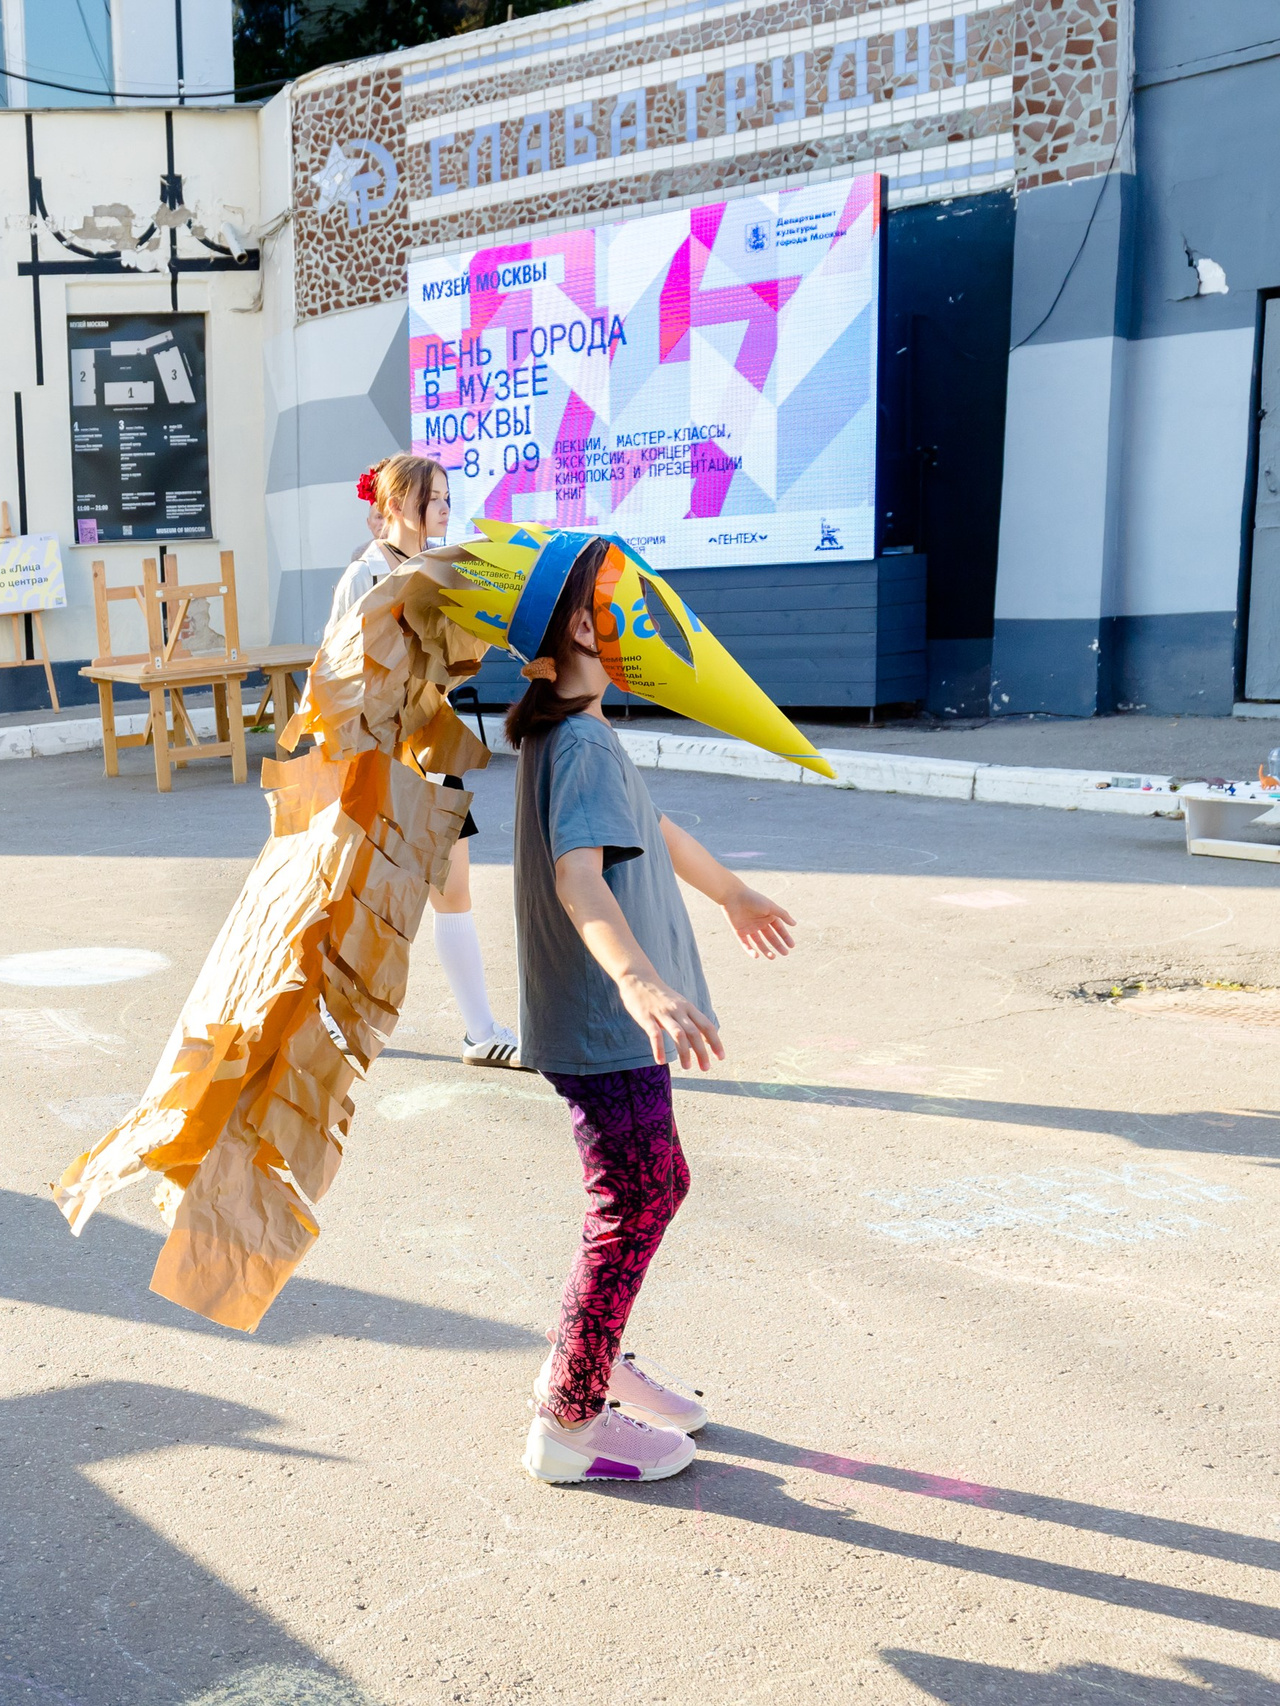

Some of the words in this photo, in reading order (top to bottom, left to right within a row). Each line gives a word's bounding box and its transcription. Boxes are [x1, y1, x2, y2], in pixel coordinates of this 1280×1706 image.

[431, 87, 646, 196] СЛАВА
[677, 14, 967, 142] ТРУДУ!
[422, 272, 472, 302] МУЗЕЙ
[475, 261, 547, 292] МОСКВЫ
[423, 336, 493, 380] ДЕНЬ
[511, 314, 628, 361] ГОРОДА
[80, 371, 87, 382] 2
[171, 369, 178, 381] 3
[425, 379, 440, 410] В
[459, 363, 549, 406] МУЗЕЕ
[127, 387, 135, 399] 1
[425, 405, 532, 446] МОСКВЫ
[554, 436, 607, 454] ЛЕКЦИИ,
[616, 424, 732, 448] МАСТЕР-КЛАССЫ,
[554, 450, 631, 470] ЭКСКУРСИИ,
[641, 442, 706, 462] КОНЦЕРТ,
[555, 466, 625, 486] КИНОПОКАЗ
[633, 467, 641, 479] И
[649, 455, 743, 477] ПРЕЗЕНТАЦИИ
[555, 485, 586, 501] КНИГ
[8, 575, 49, 588] центра»
[9, 562, 41, 574] «Лица
